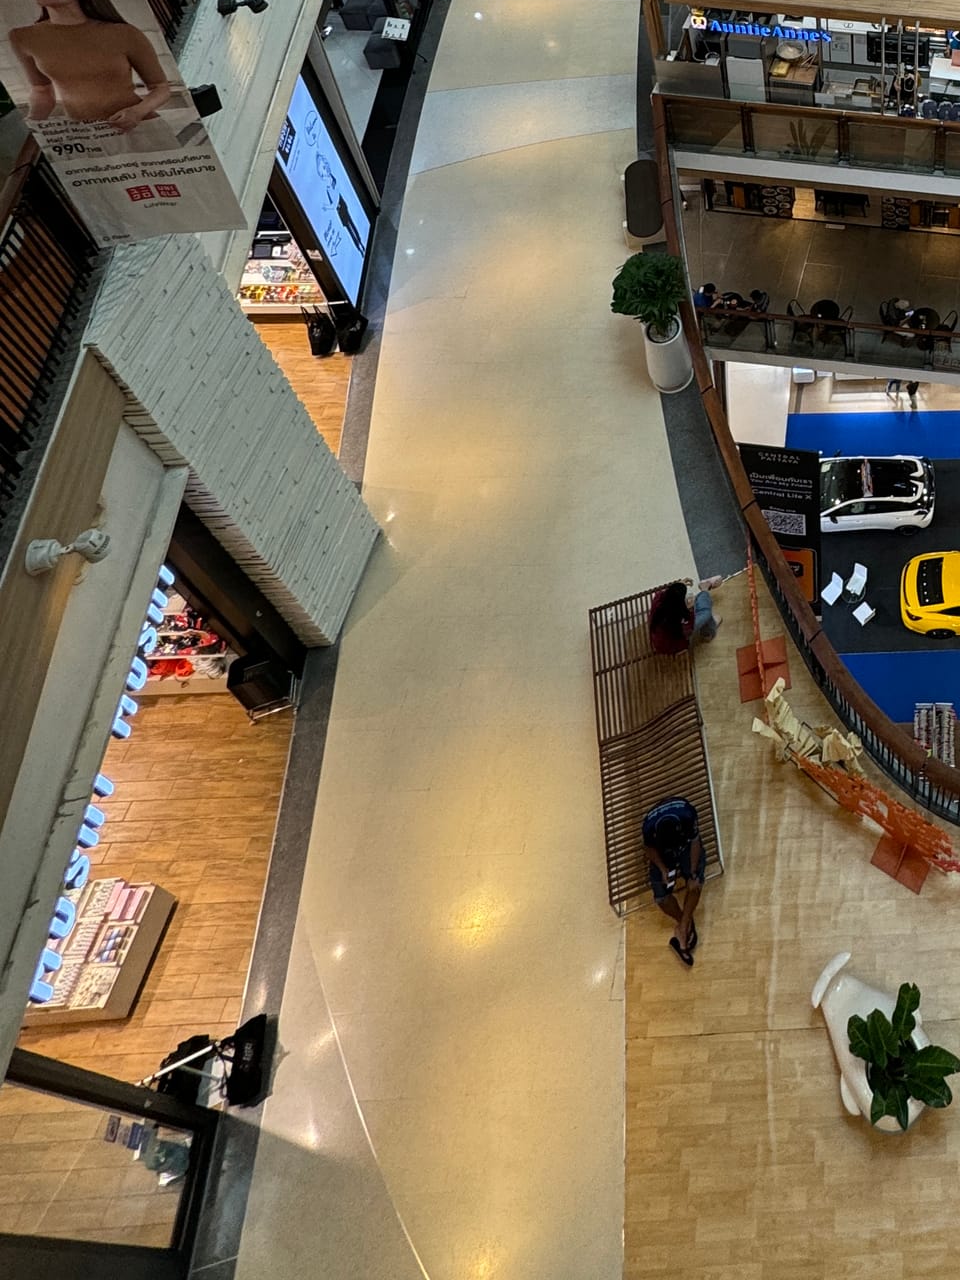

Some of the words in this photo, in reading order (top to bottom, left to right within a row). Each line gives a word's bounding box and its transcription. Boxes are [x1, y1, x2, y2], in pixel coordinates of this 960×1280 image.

[710, 19, 771, 37] Auntie
[772, 25, 832, 43] Anne's
[52, 143, 86, 156] 990
[758, 451, 801, 461] CENTRAL
[761, 456, 799, 464] PATTAYA
[752, 488, 785, 498] Central
